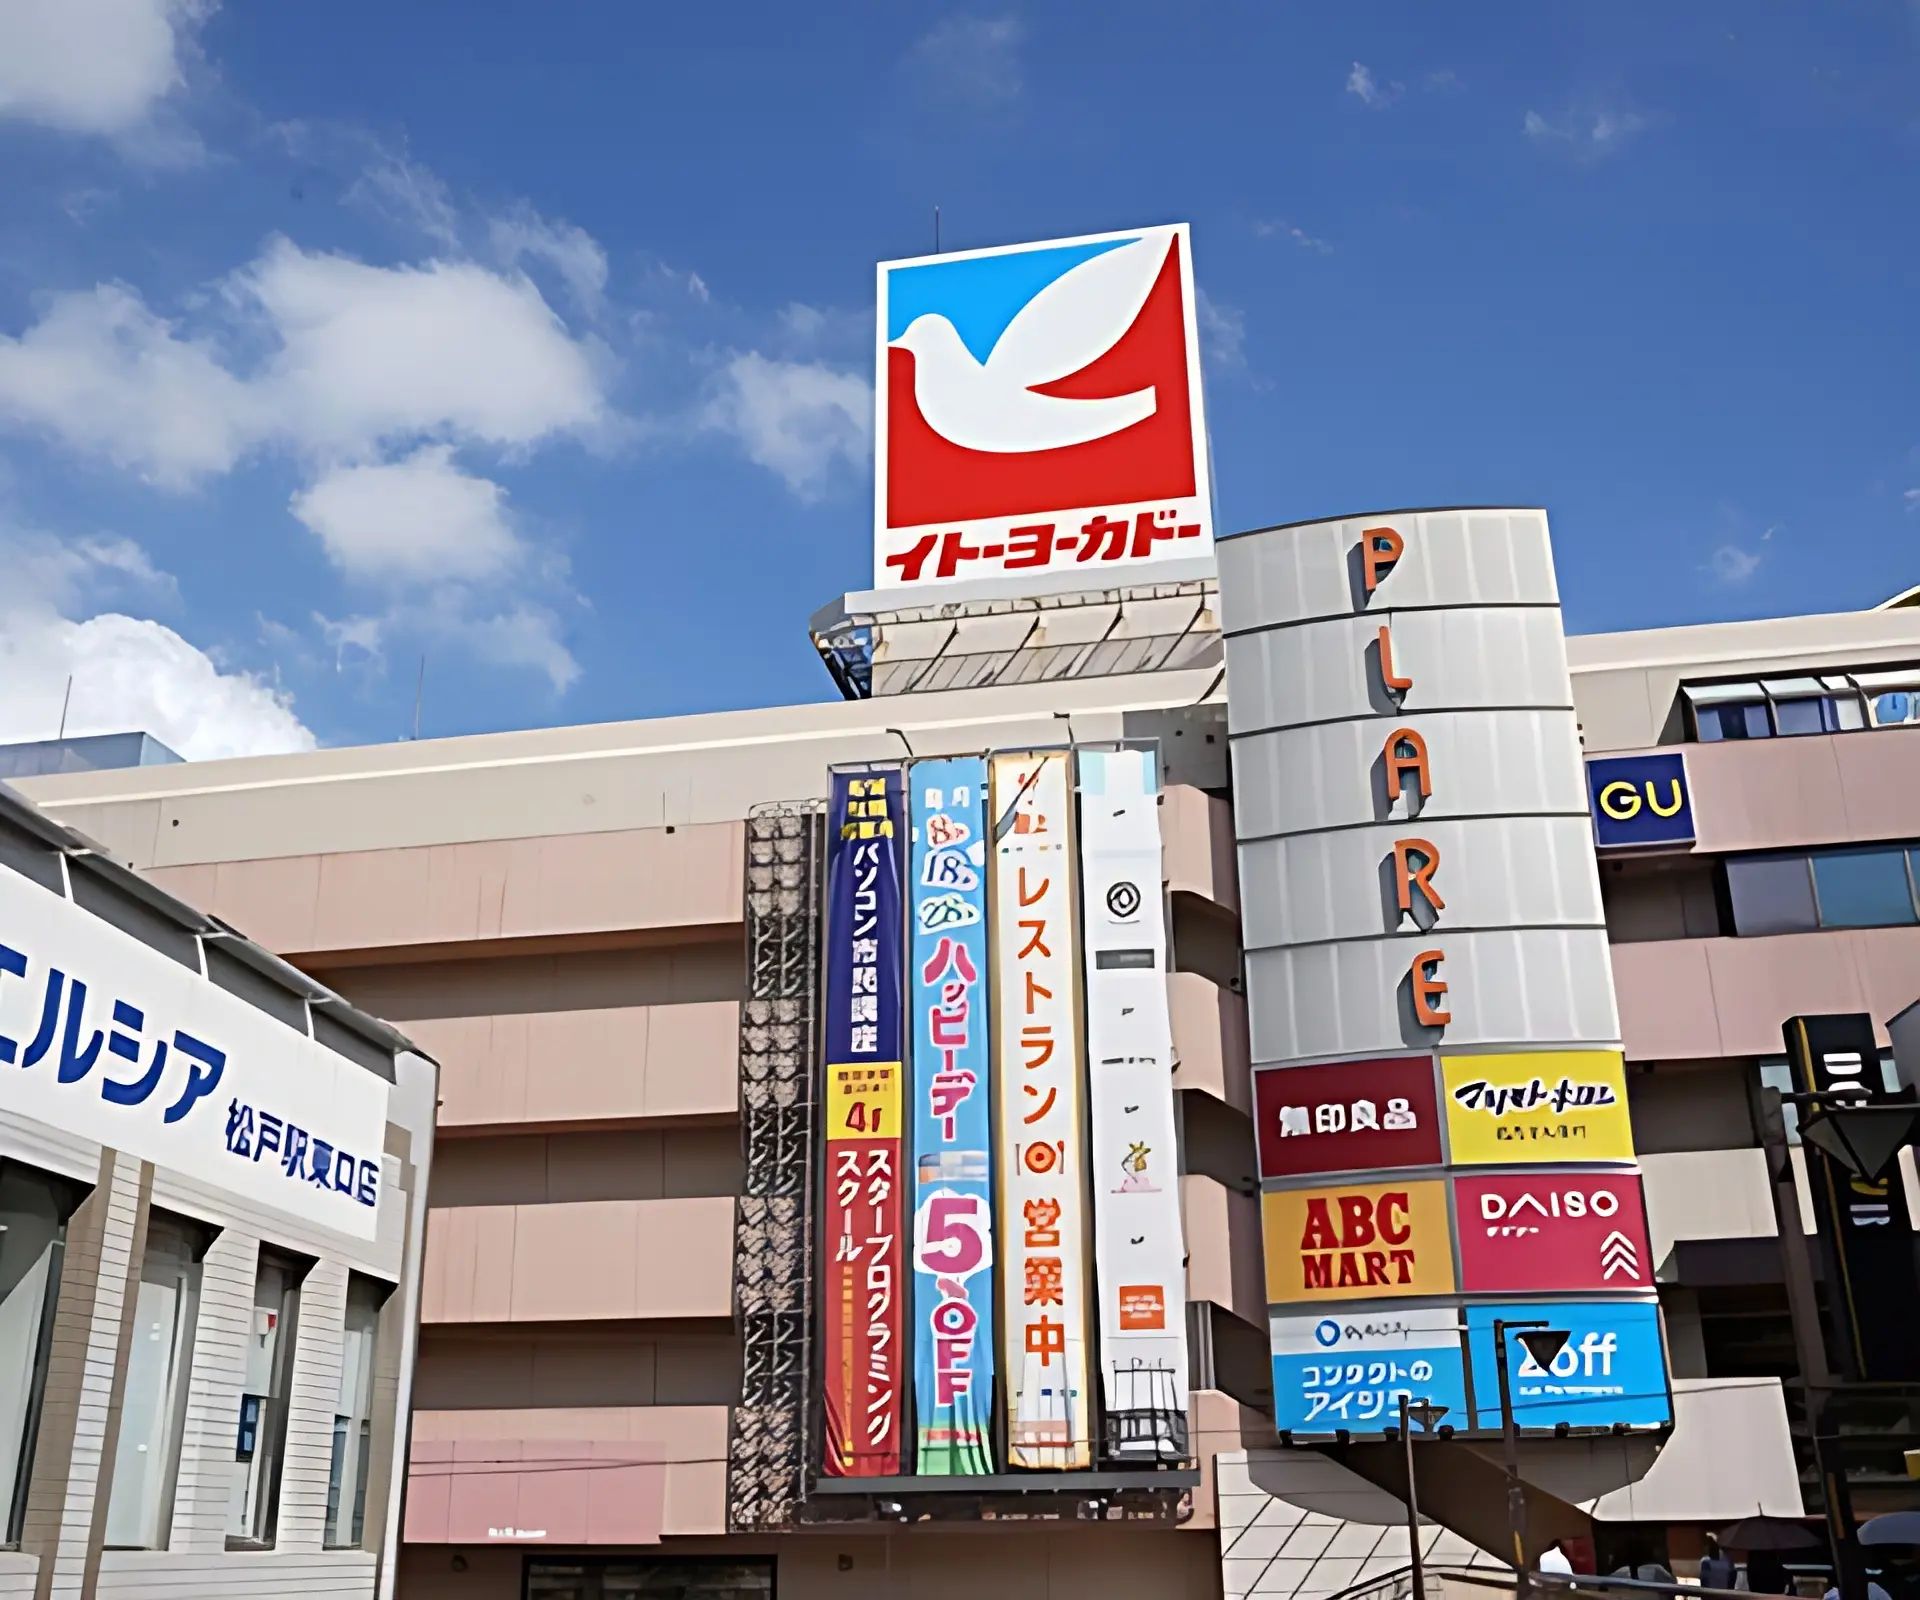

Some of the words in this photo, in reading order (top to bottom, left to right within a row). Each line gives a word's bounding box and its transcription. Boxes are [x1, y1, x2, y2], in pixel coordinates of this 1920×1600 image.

[886, 509, 1200, 581] イトーヨーカドー
[1361, 527, 1451, 1027] PLARE
[1600, 778, 1683, 820] GU
[1018, 867, 1056, 1125] レストラン
[1301, 1192, 1411, 1250] ABC
[1481, 1190, 1619, 1220] DAISO
[1302, 1250, 1415, 1289] MART
